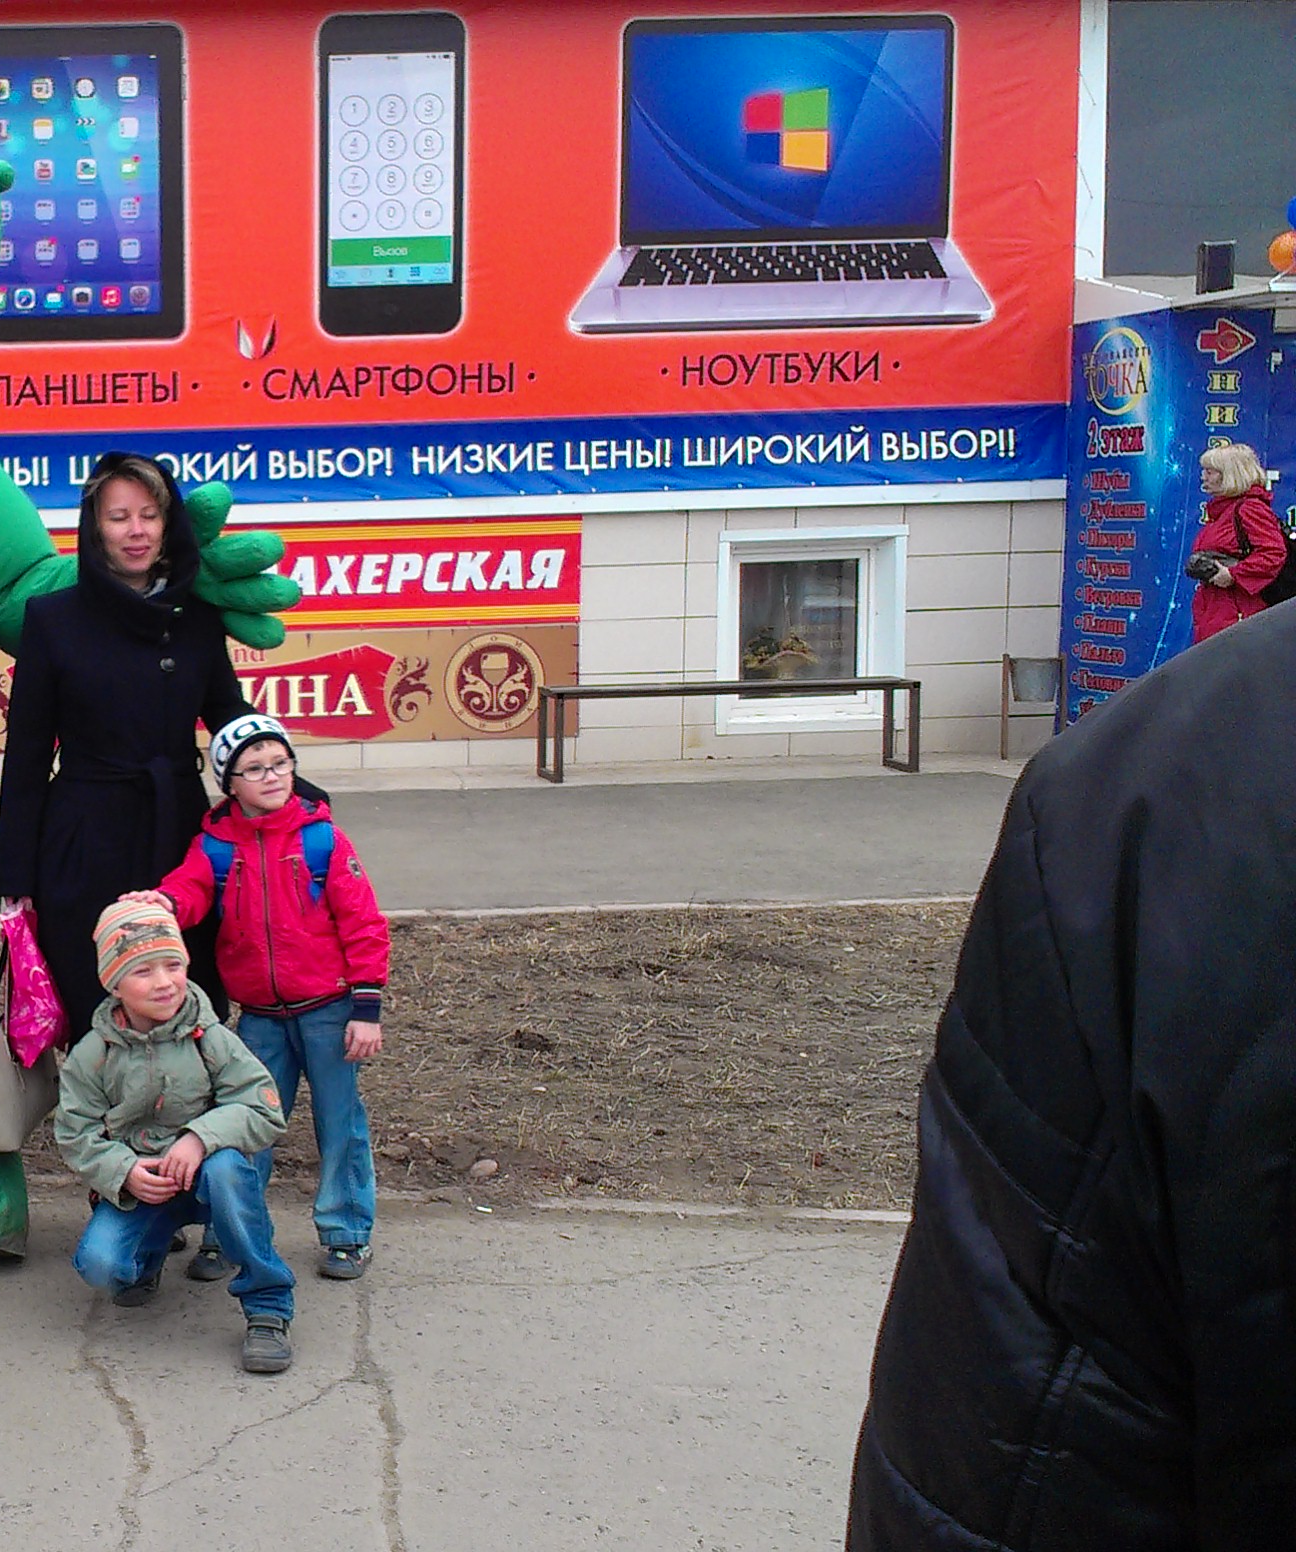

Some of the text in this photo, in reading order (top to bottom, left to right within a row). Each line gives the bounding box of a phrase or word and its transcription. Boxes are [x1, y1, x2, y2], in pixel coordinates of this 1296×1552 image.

[263, 362, 515, 400] СМАРТФОНЫ
[681, 351, 881, 386] НОУТБУКИ
[1084, 361, 1148, 401] ТОЧКА
[69, 443, 257, 486] ШОКИЙ
[268, 446, 393, 480] ВЫБОР!
[412, 442, 555, 475] НИЗКИЕ
[564, 437, 672, 475] ЦЕНЫ!
[683, 425, 871, 467] ШИРОКИЙ
[881, 428, 1016, 462] ВЫБОР!!
[1088, 417, 1145, 458] 2 этаж
[286, 549, 566, 596] АХЕРСКАЯ
